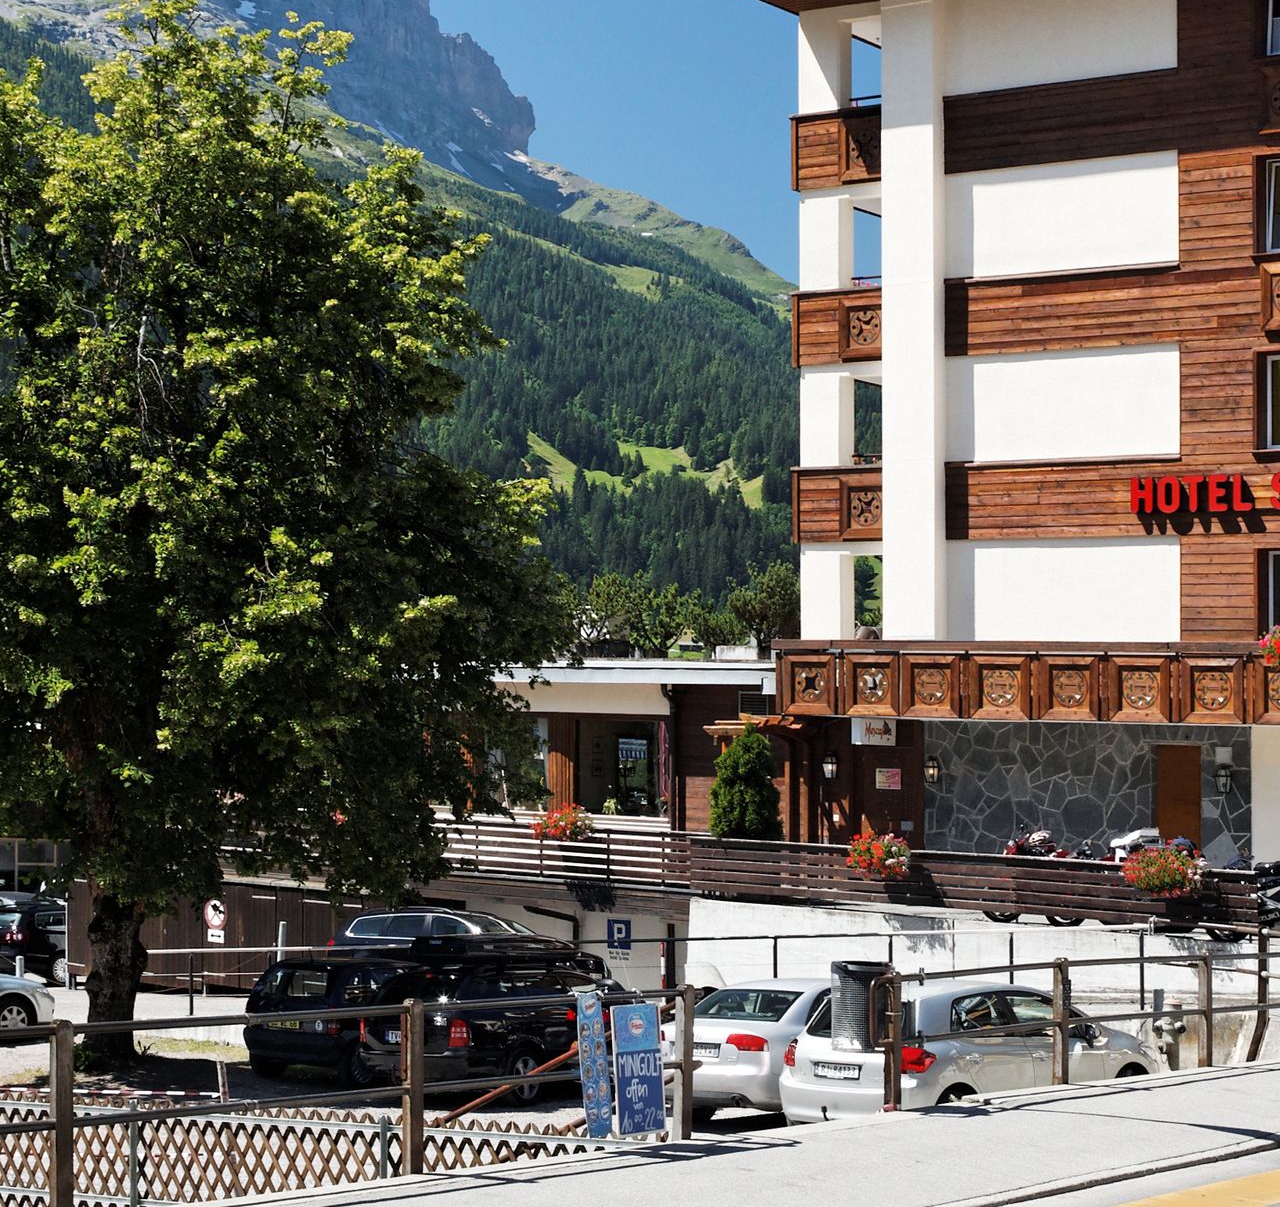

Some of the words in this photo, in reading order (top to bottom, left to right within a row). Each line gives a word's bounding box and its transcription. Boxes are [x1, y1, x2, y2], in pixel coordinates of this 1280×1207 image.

[1130, 473, 1254, 514] HOTEL
[613, 923, 626, 946] P
[618, 1052, 663, 1078] MINIGOLF
[626, 1079, 649, 1102] offen
[633, 1102, 644, 1111] von
